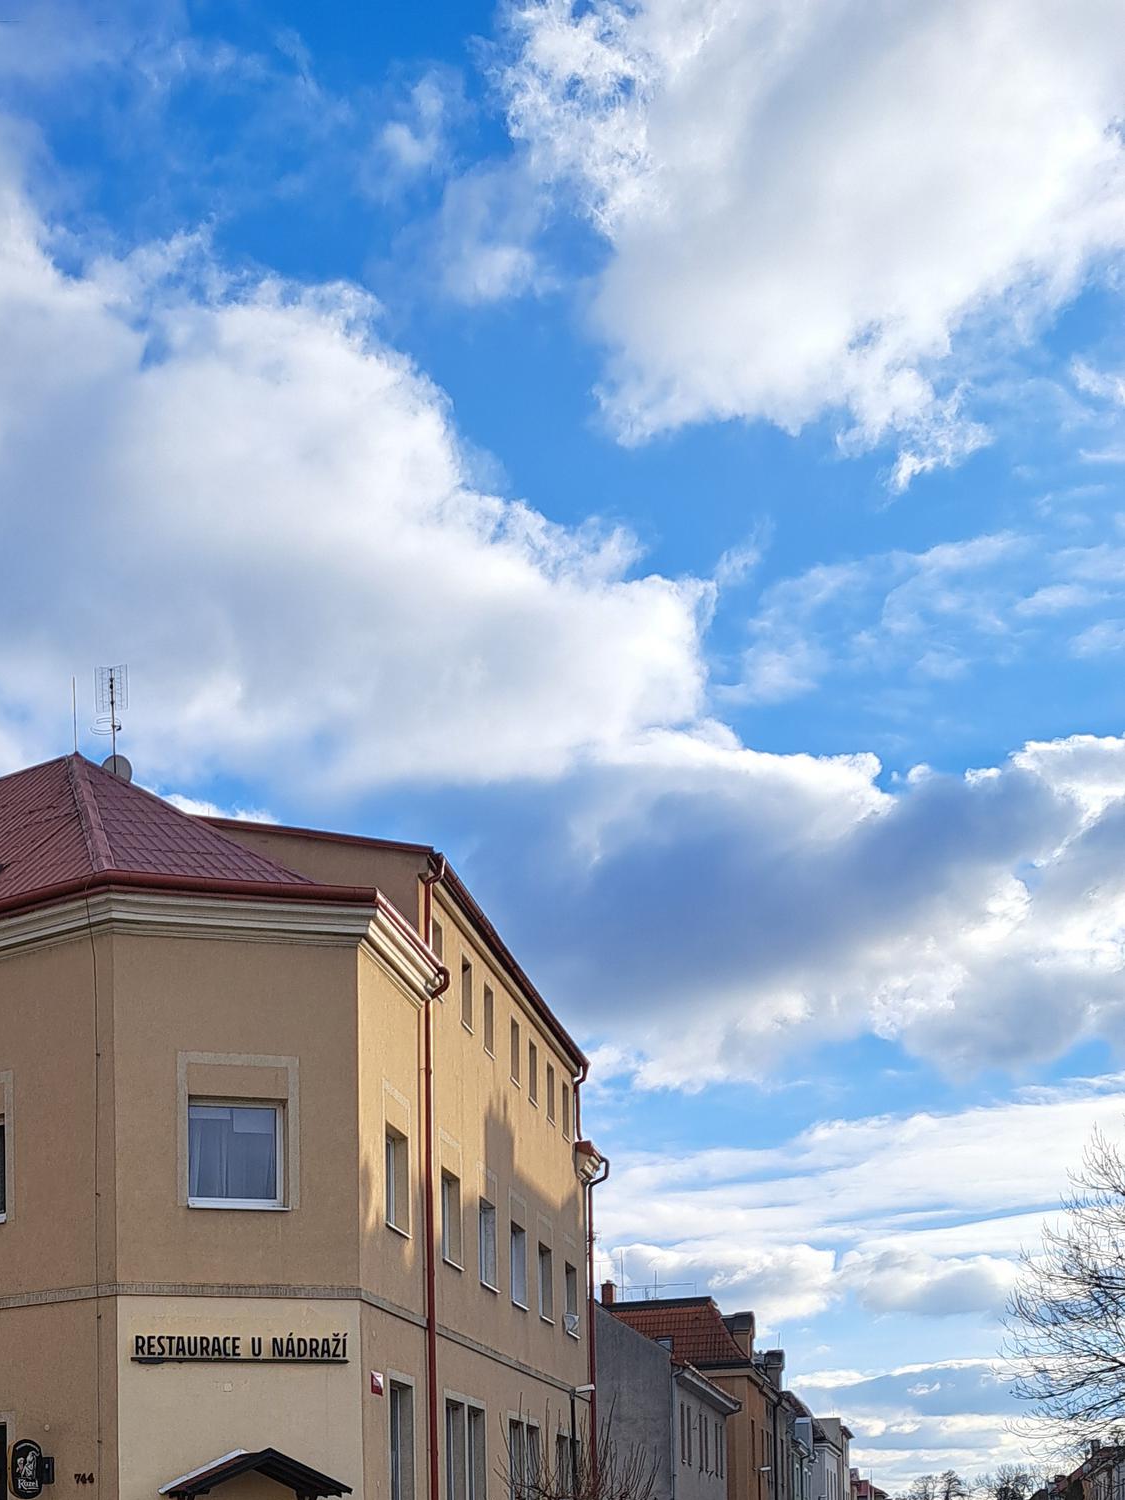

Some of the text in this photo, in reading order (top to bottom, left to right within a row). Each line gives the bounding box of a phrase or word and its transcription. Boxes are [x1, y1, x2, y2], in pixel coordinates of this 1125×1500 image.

[135, 1332, 349, 1358] RESTAURACE U NÁDRAŽÍ
[18, 1479, 40, 1490] Kozel
[74, 1472, 95, 1485] 744
